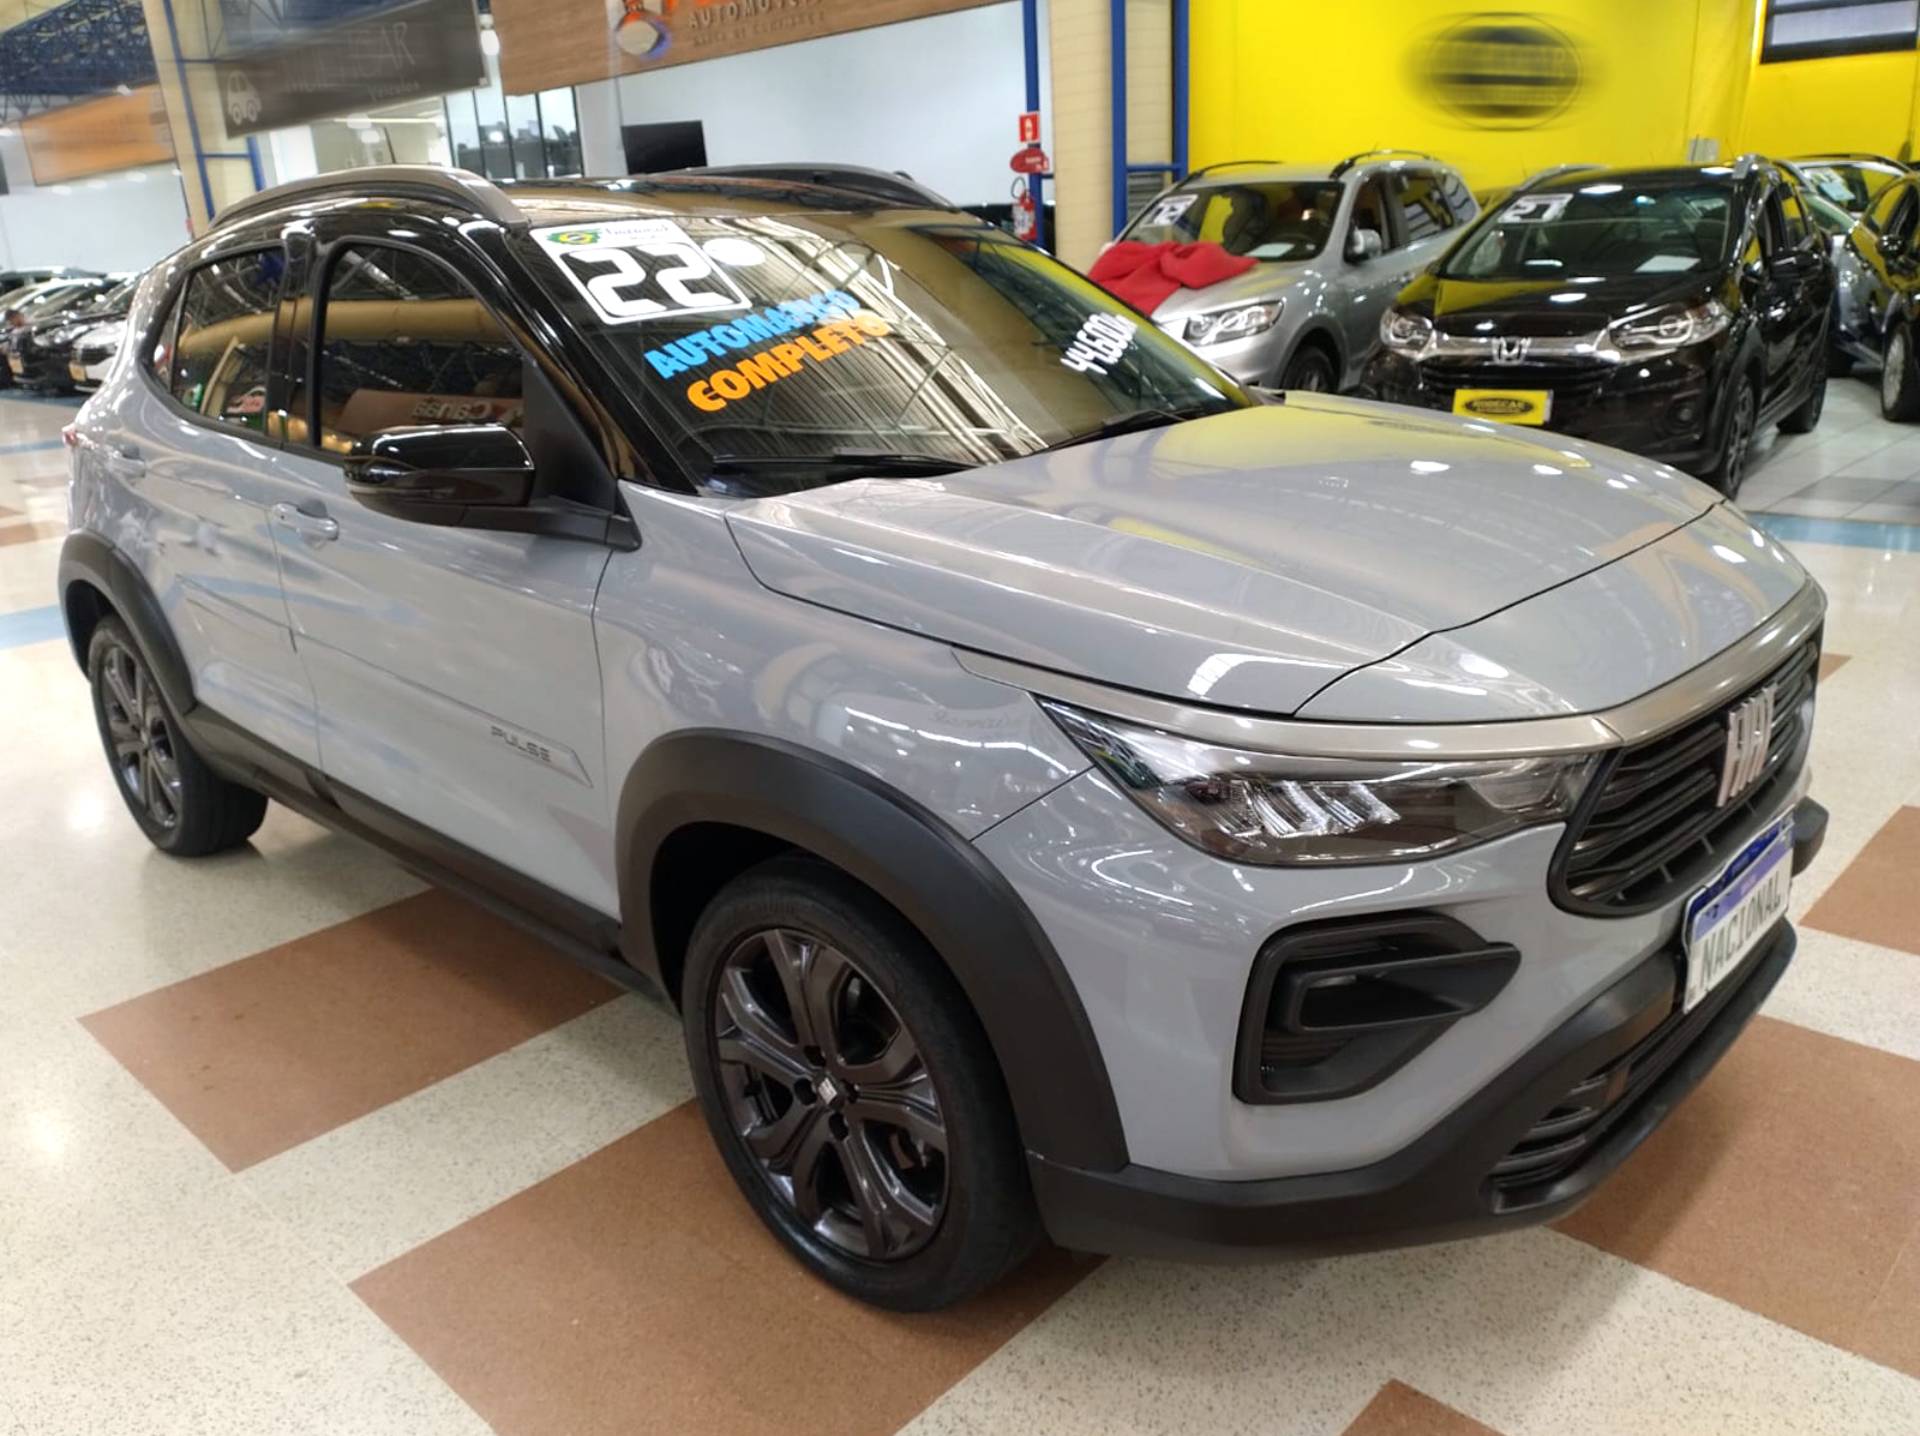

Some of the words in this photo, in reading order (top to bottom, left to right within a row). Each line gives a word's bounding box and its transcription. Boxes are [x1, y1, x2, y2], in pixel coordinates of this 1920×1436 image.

[567, 242, 737, 318] 22
[686, 311, 893, 412] COMPLETO
[490, 725, 552, 763] PULSE
[1700, 869, 1781, 990] NACIONAL
